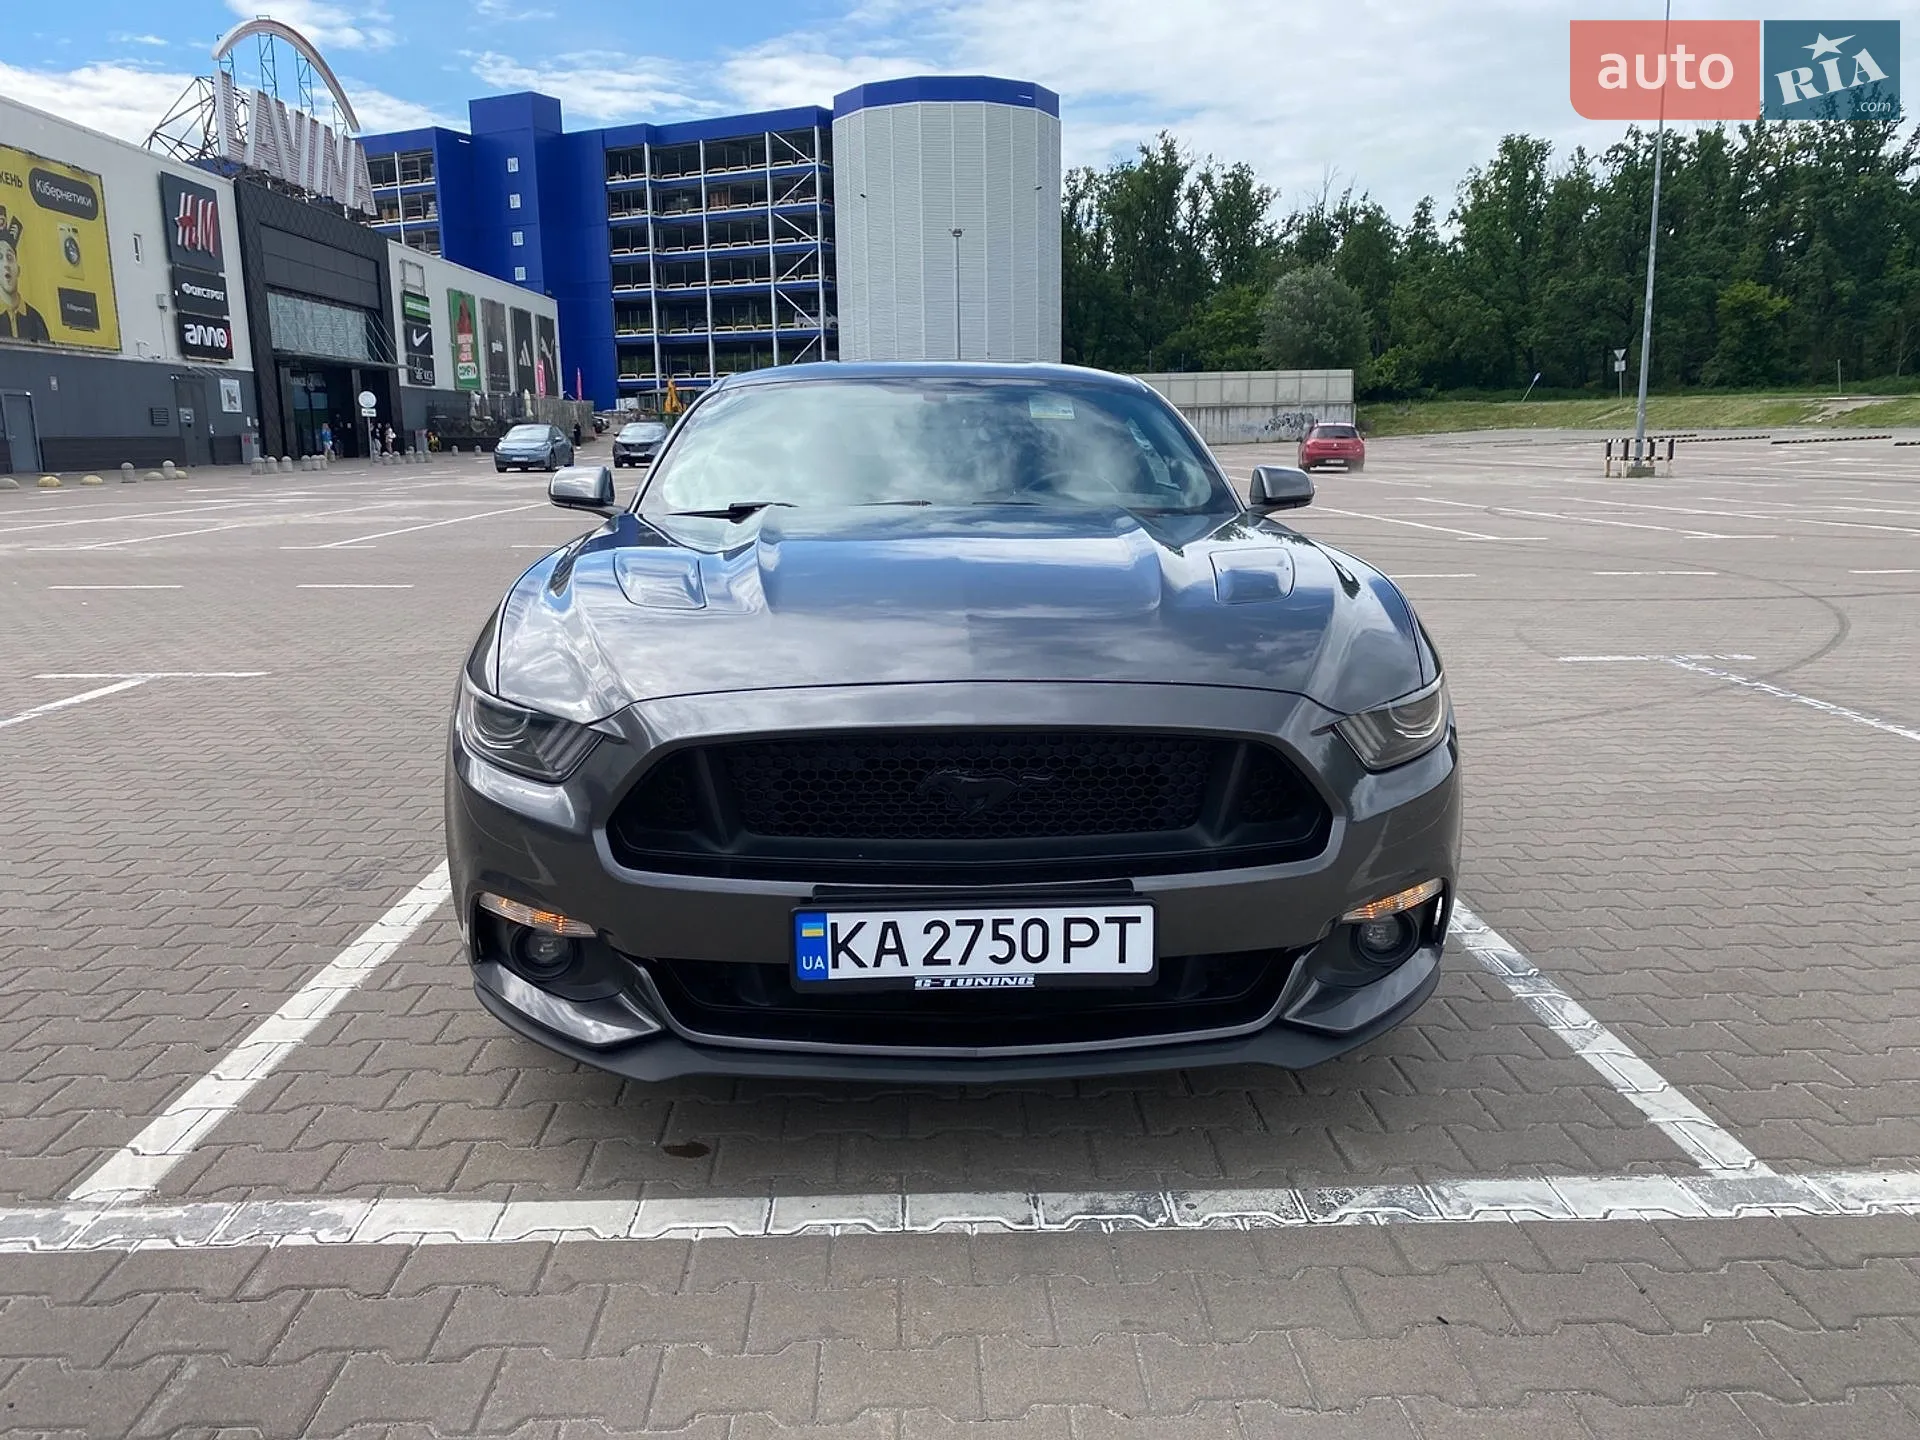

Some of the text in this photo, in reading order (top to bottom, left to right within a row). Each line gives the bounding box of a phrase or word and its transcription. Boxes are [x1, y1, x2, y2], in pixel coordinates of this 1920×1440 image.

[214, 69, 378, 216] LAVINA
[802, 957, 825, 970] UA
[830, 916, 1142, 969] KA 2750 PT
